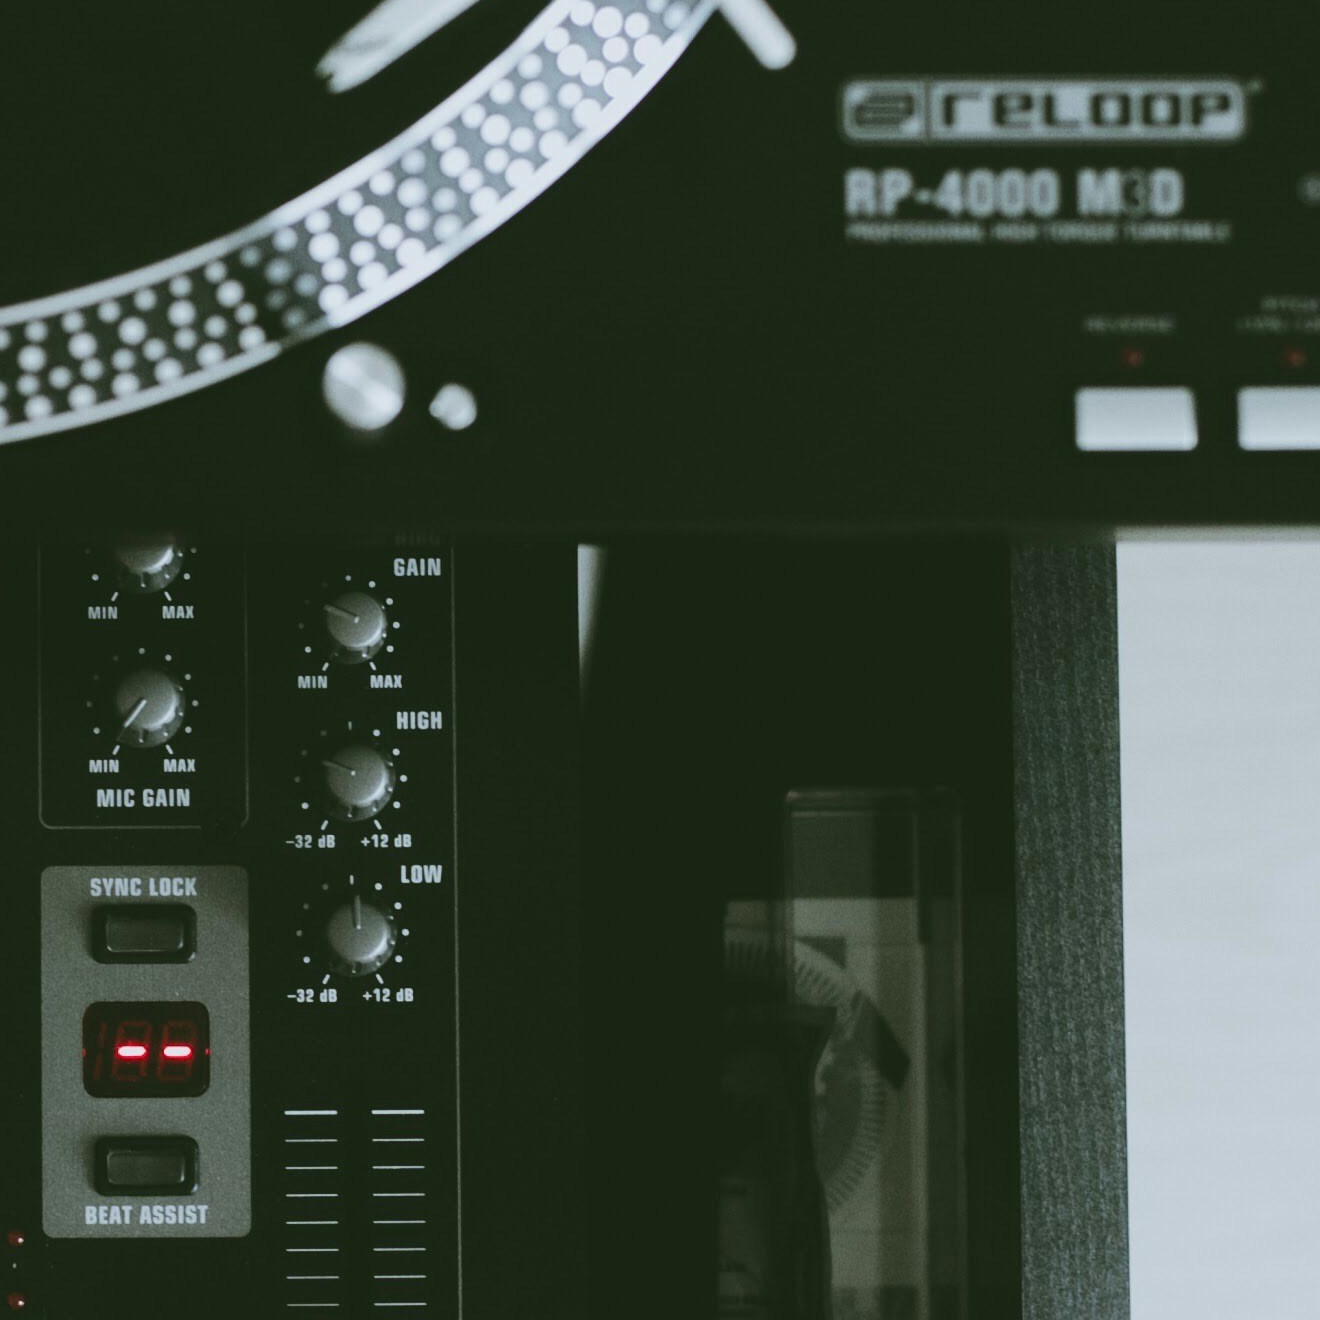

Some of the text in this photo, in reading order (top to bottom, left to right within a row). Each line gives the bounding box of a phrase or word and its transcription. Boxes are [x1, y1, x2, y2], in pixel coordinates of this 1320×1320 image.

[844, 167, 1184, 219] RP-4000 M3D
[393, 557, 442, 577] GAIN
[87, 605, 118, 620] MIN
[161, 605, 195, 620] MAX
[297, 675, 328, 689] MIN
[369, 674, 403, 689] MAX
[396, 710, 443, 730] HIGH
[88, 758, 120, 774] MIN
[163, 758, 196, 773] MAX
[96, 788, 191, 808] MIC GAIN
[285, 834, 336, 849] -32 dB
[360, 833, 412, 848] +12 dB
[400, 864, 443, 884] LOW
[89, 877, 198, 897] SYNC LOCK
[286, 988, 338, 1003] -32 dB
[362, 987, 414, 1003] +12 dB
[84, 1204, 209, 1225] BEAT ASSIST
